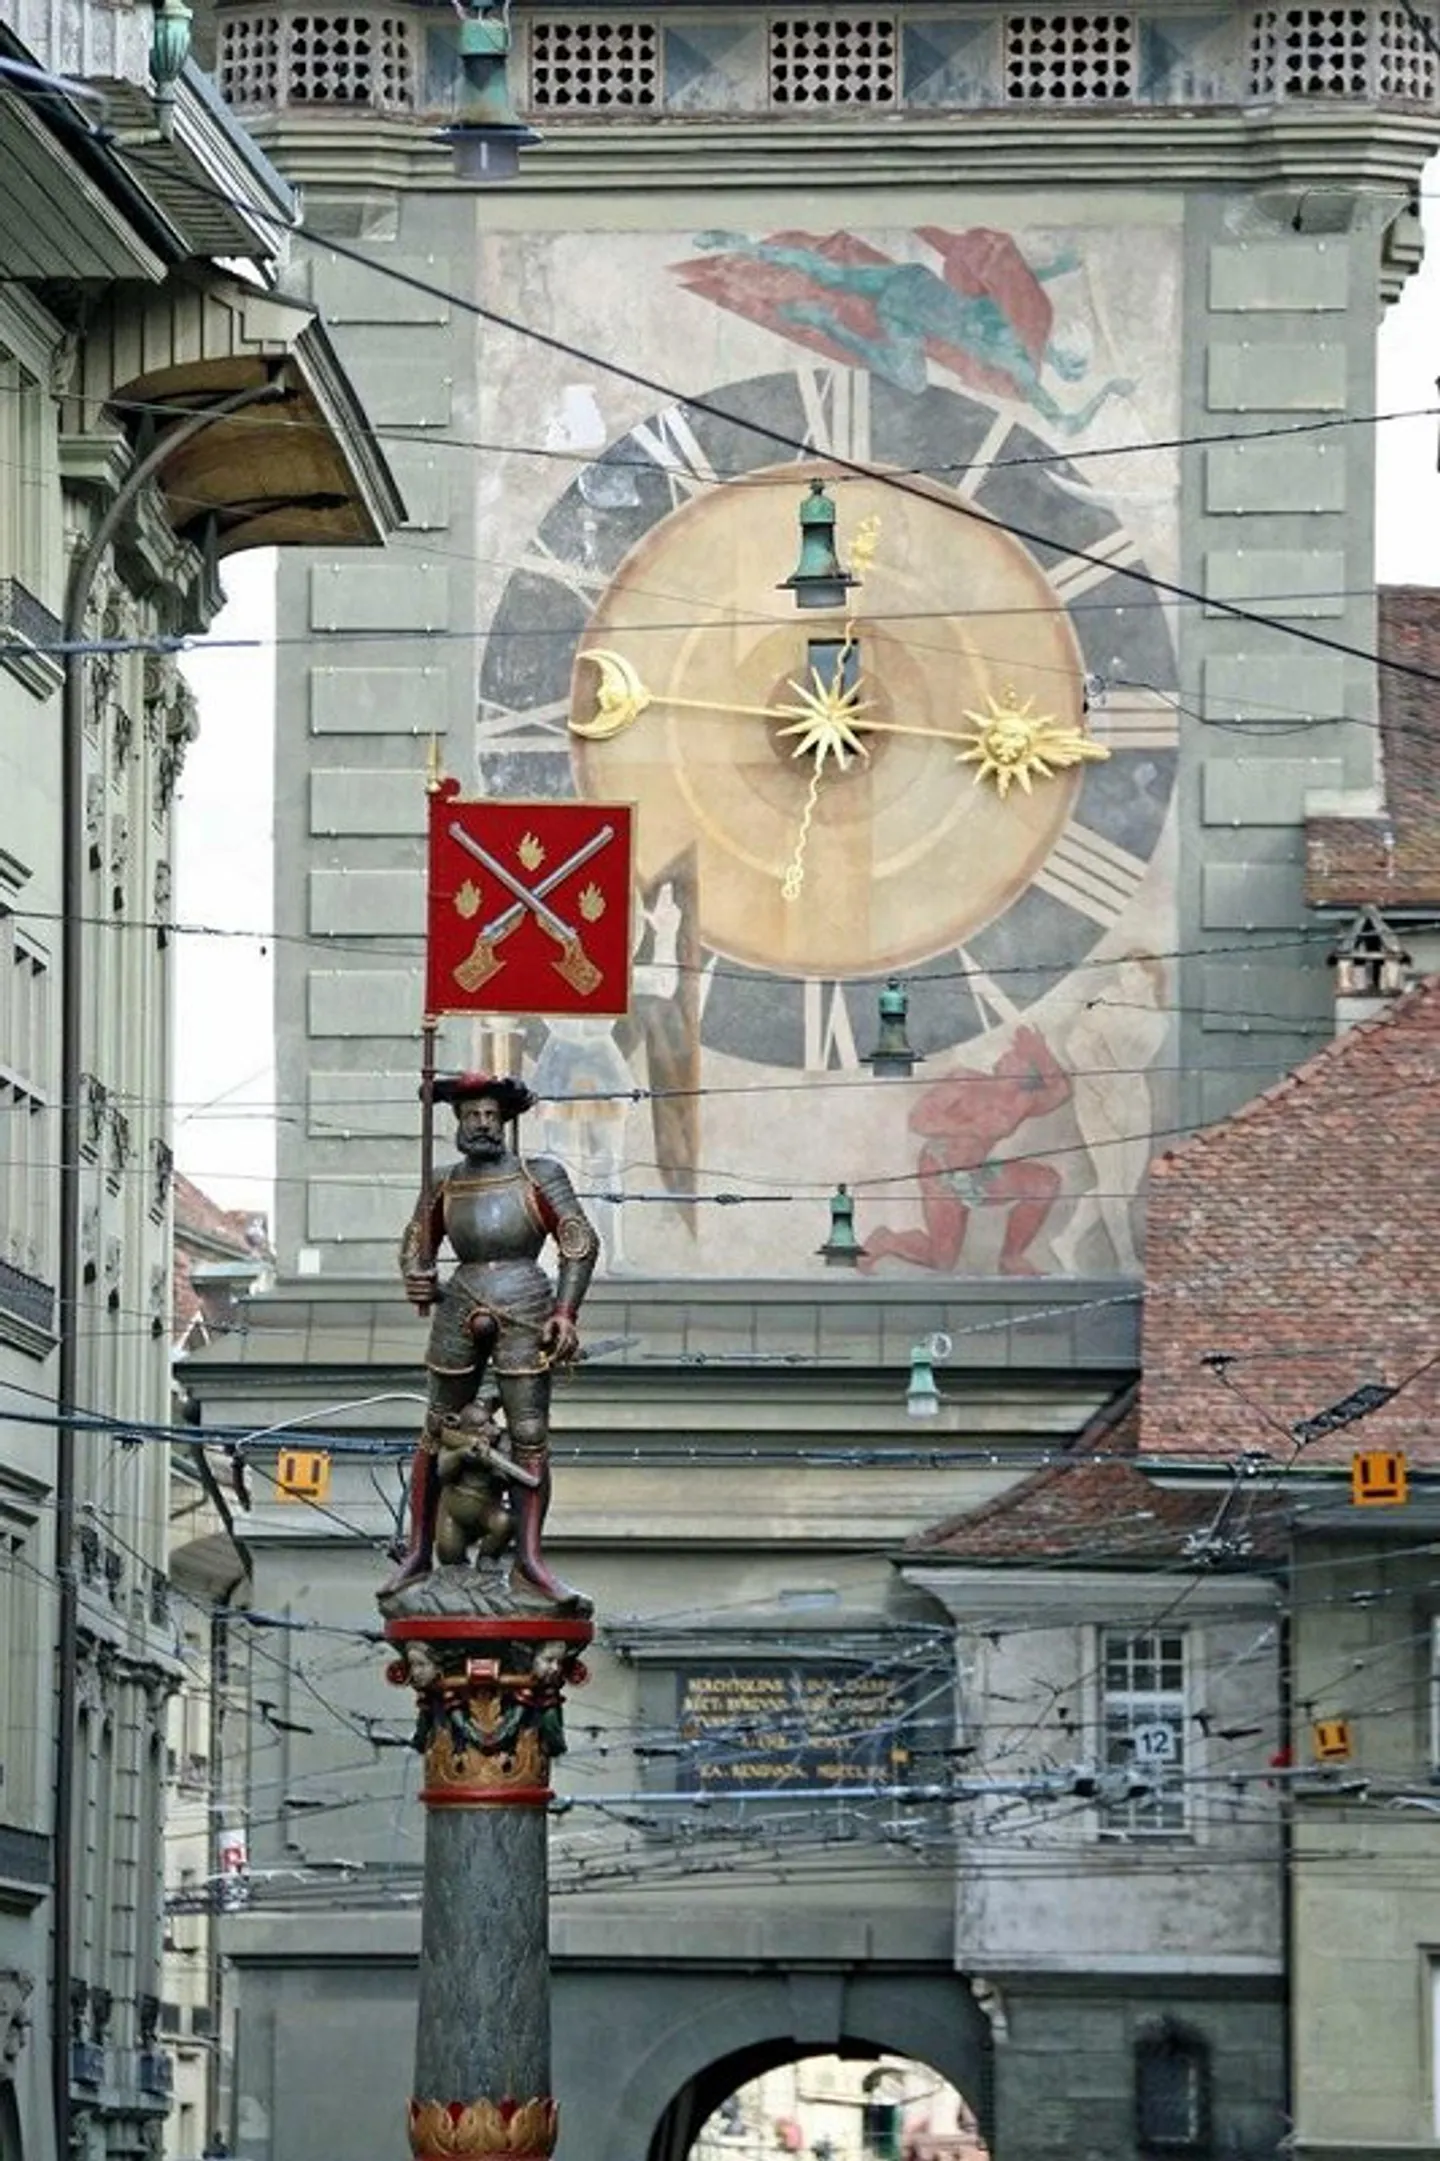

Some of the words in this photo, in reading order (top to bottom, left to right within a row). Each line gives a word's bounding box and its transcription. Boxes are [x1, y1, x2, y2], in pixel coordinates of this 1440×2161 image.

[630, 405, 720, 507] XI
[797, 367, 870, 462] XII
[957, 408, 1016, 500] I
[510, 538, 608, 610] X
[1045, 529, 1142, 600] II
[477, 697, 574, 753] IX
[1087, 690, 1180, 748] III
[1032, 820, 1150, 929] IIII
[804, 979, 859, 1070] VI
[957, 947, 1021, 1034] V
[1141, 1729, 1169, 1754] 12
